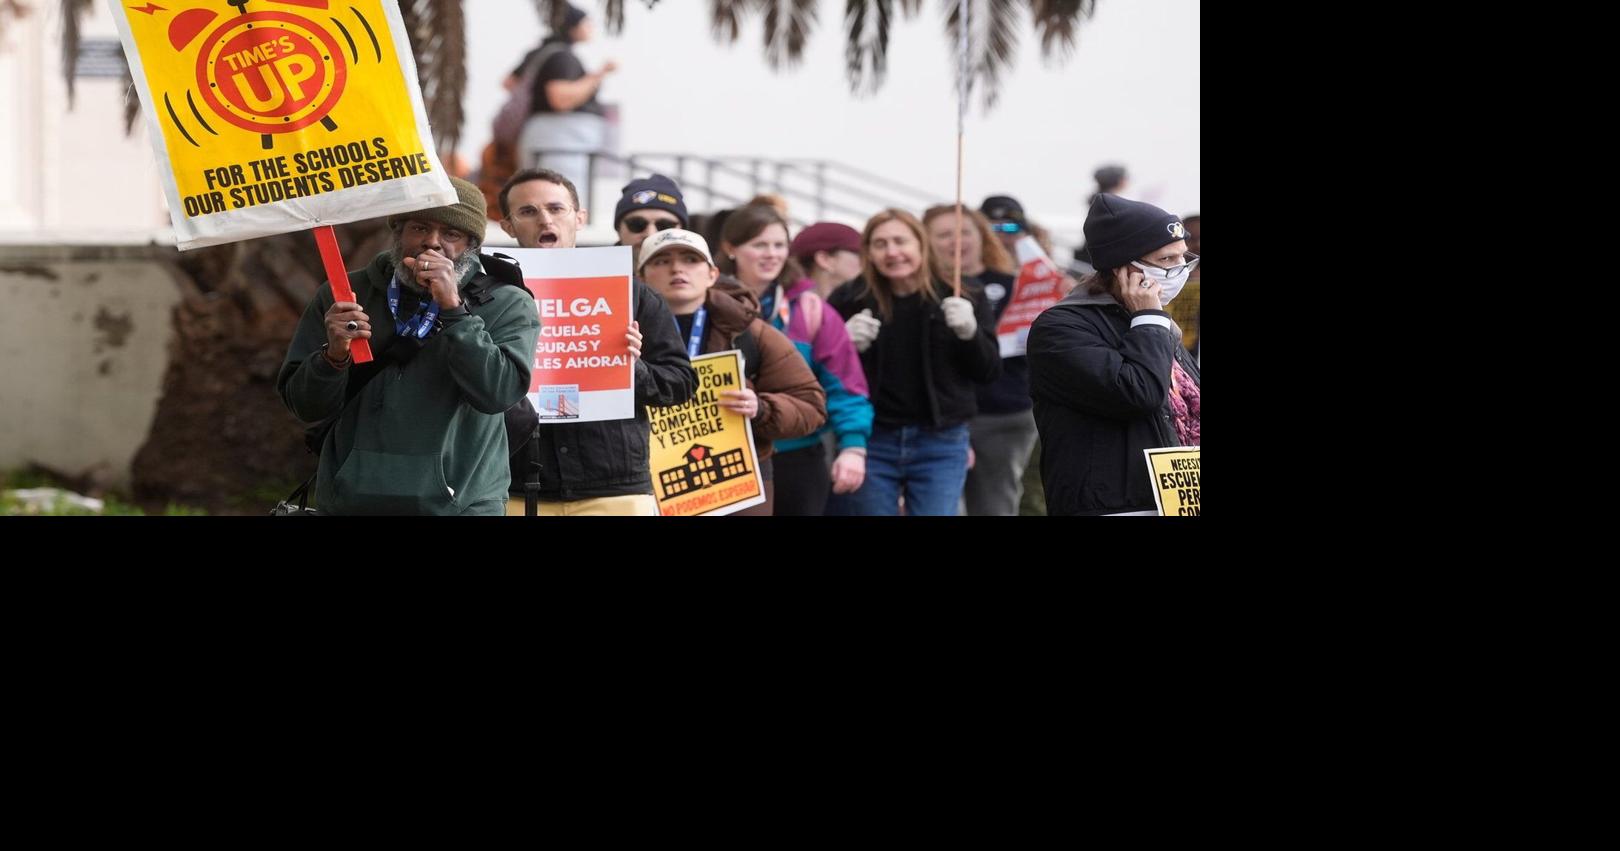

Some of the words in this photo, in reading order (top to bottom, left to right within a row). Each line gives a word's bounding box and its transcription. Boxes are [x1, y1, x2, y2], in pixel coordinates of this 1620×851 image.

[223, 35, 296, 72] TIME'S
[232, 53, 316, 112] UP
[204, 164, 243, 190] FOR
[249, 156, 286, 181] THE
[293, 137, 389, 174] SCHOOLS
[183, 191, 226, 217] OUR
[232, 172, 335, 208] STUDENTS
[338, 153, 431, 186] DESERVE
[540, 324, 601, 337] CUELAS
[590, 340, 601, 352] Y
[533, 357, 562, 370] LES
[565, 355, 628, 369] AHORA!
[703, 372, 733, 389] CON
[650, 404, 719, 435] COMPLETO
[657, 435, 666, 448] Y
[669, 418, 724, 445] ESTABLE
[1178, 489, 1200, 506] PER
